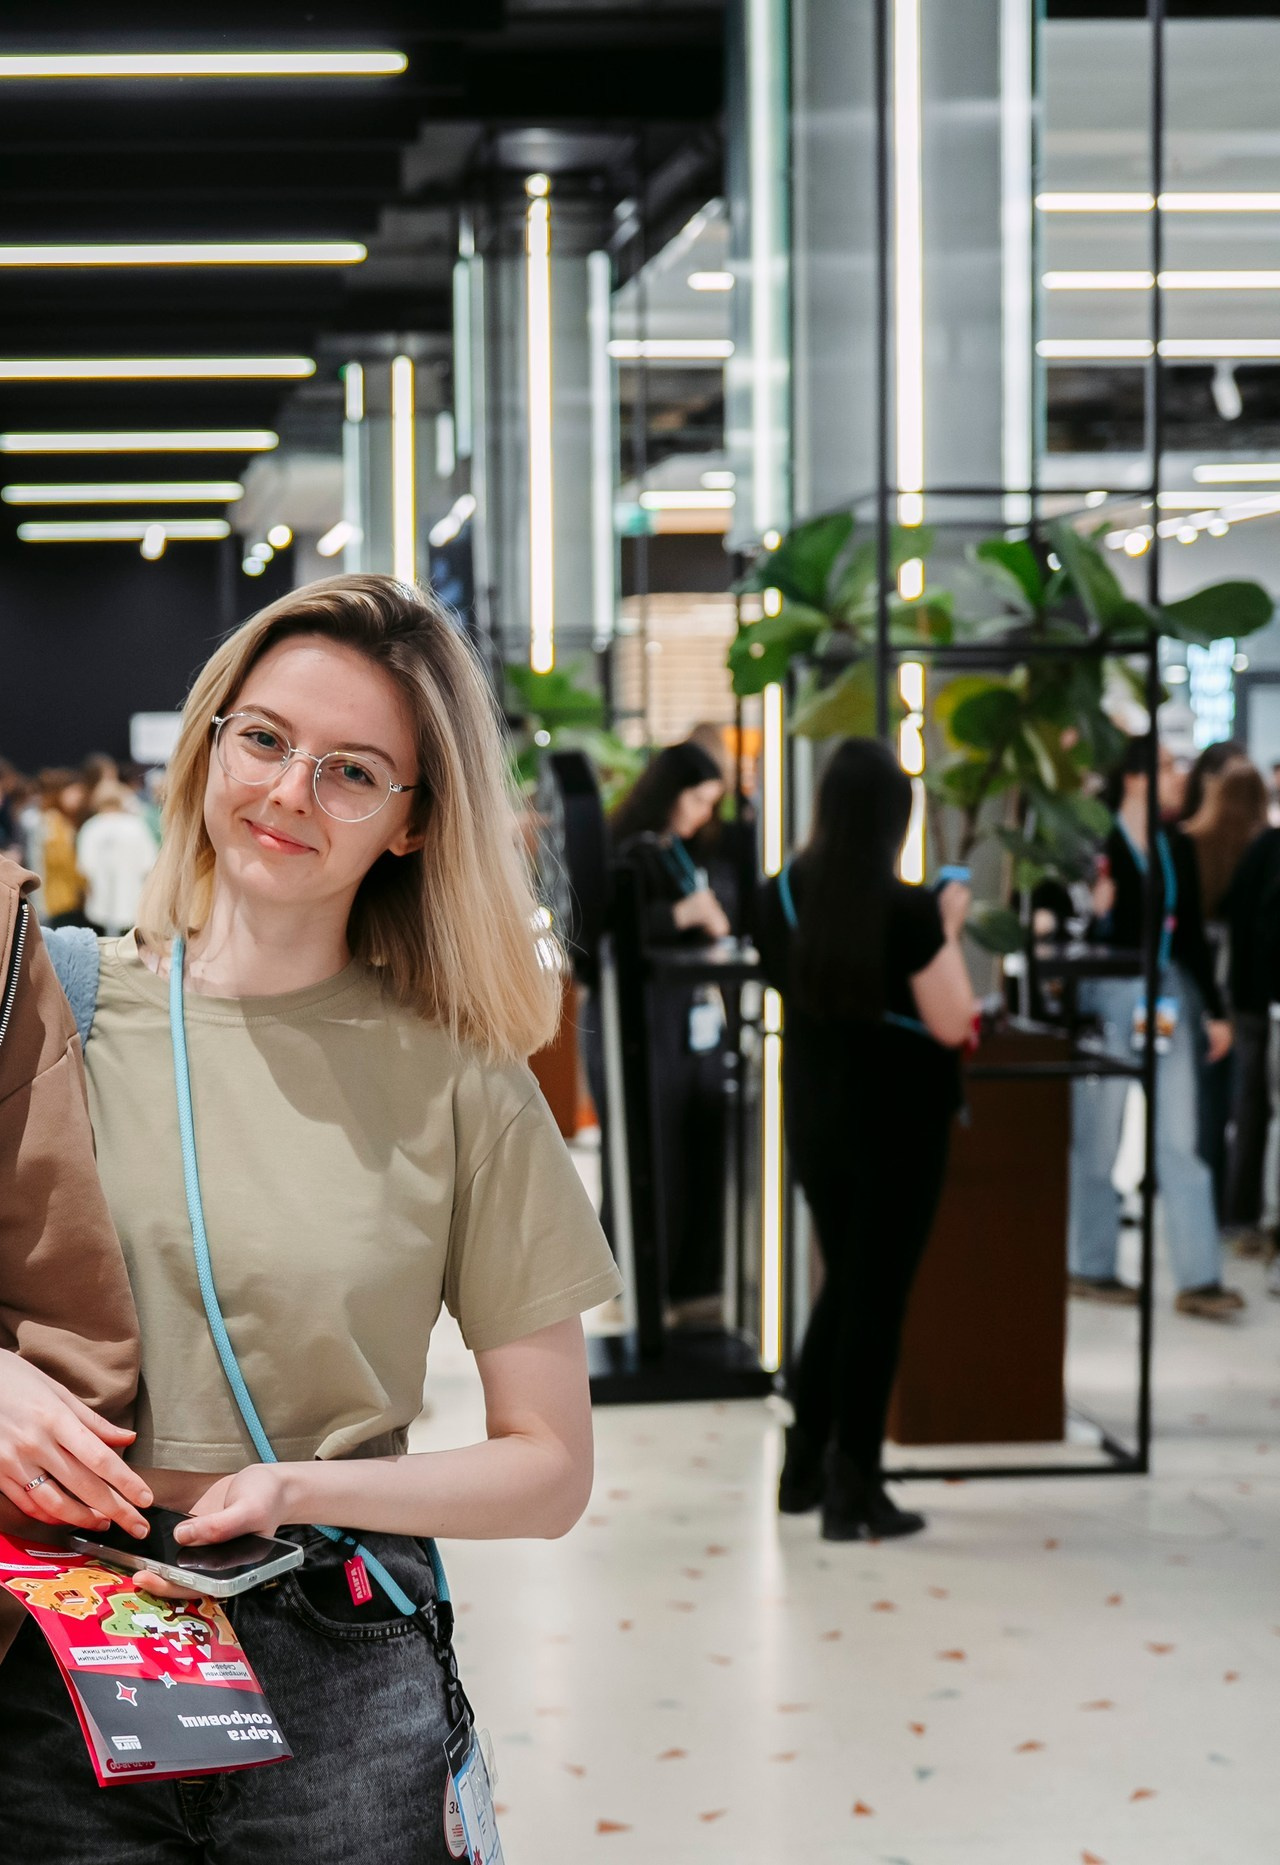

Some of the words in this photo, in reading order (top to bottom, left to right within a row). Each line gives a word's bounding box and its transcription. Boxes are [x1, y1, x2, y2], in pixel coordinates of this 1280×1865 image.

[350, 1567, 364, 1599] ЛИГА
[177, 1710, 273, 1728] сокровищ
[226, 1726, 283, 1744] Карта
